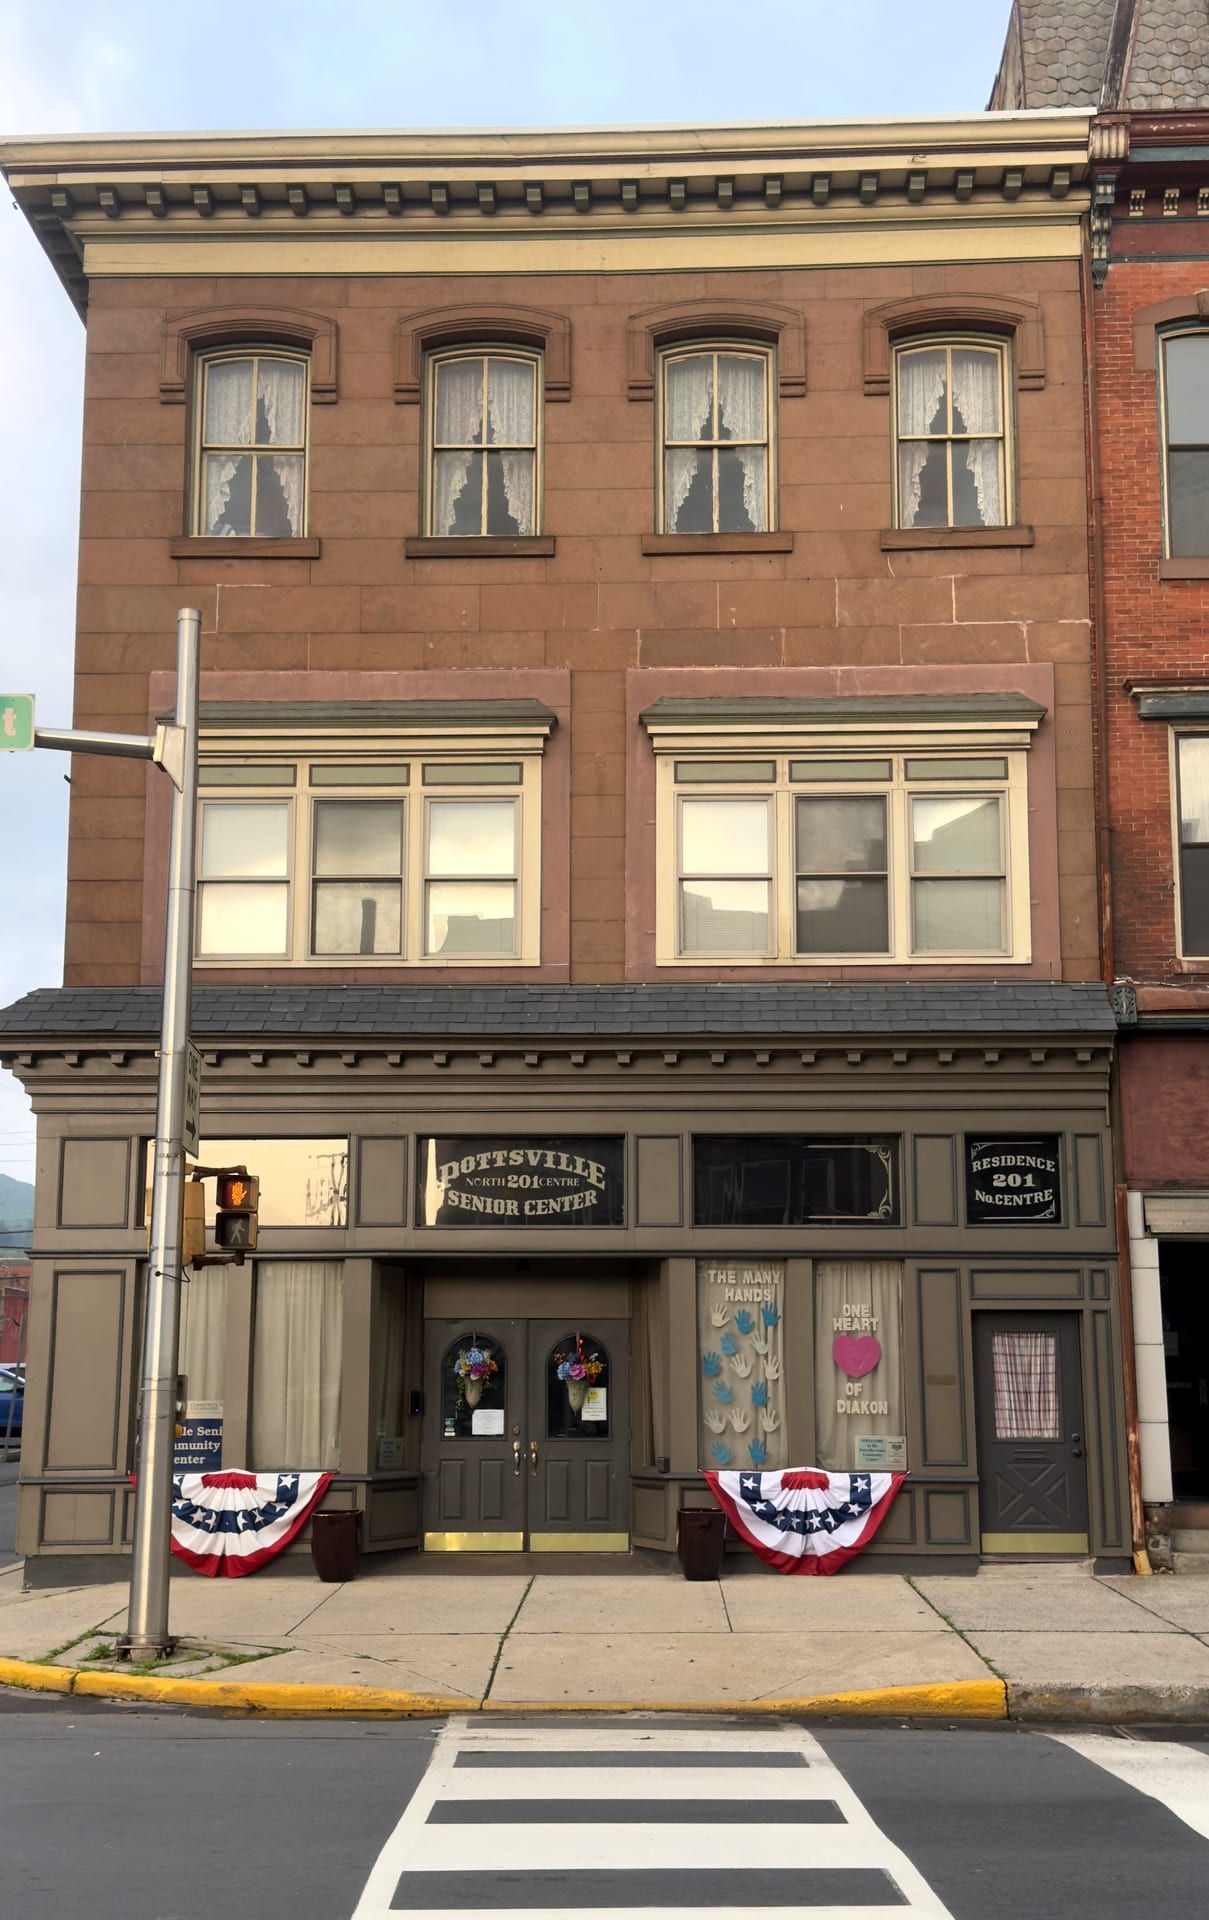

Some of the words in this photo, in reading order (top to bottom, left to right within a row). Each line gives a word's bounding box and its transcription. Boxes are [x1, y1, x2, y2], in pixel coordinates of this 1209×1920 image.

[188, 1051, 198, 1082] ONE
[439, 1149, 606, 1191] POTTSVILLE
[971, 1155, 1055, 1172] RESIDENCE
[465, 1177, 506, 1187] NORTH
[507, 1175, 539, 1189] 201
[539, 1177, 580, 1187] CENTRE
[992, 1173, 1036, 1187] 201
[447, 1190, 520, 1216] SENIOR
[524, 1189, 598, 1216] CENTER
[708, 1270, 736, 1284] THE
[742, 1270, 782, 1285] MANY
[724, 1287, 773, 1302] HANDS
[842, 1304, 871, 1318] ONE
[832, 1317, 879, 1331] HEART
[845, 1382, 863, 1396] OF
[836, 1400, 888, 1415] DIAKON
[197, 1426, 223, 1436] Seni
[174, 1440, 221, 1452] munity
[173, 1455, 205, 1464] enter
